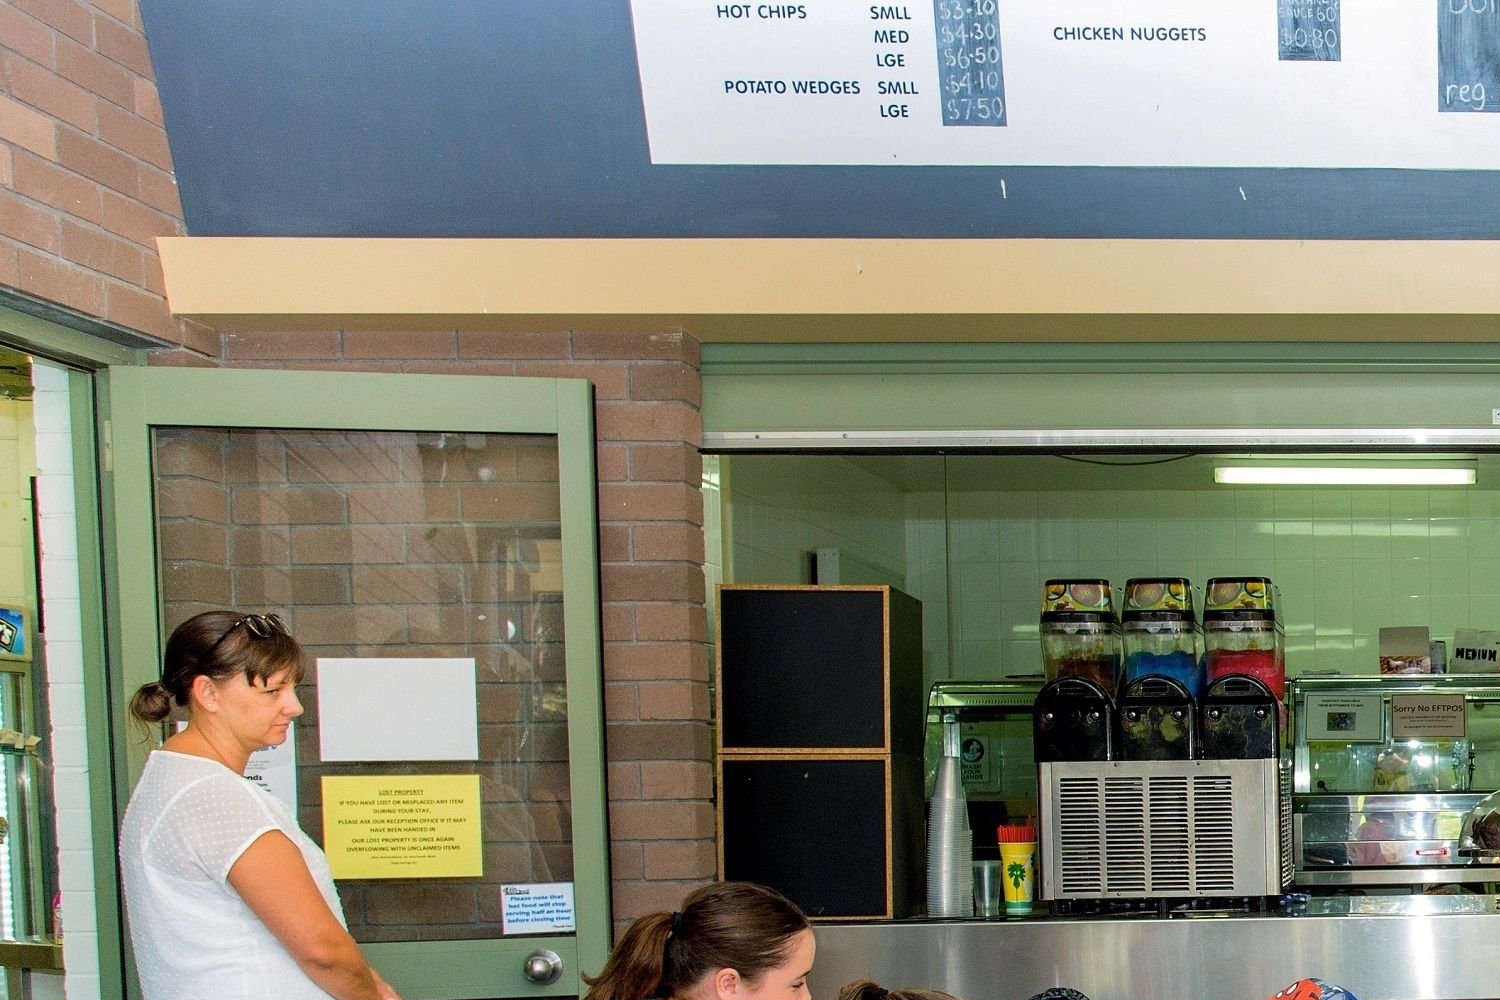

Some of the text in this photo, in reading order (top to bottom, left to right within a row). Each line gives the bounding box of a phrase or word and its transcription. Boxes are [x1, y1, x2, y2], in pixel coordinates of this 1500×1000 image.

[717, 5, 750, 19] HOT
[758, 5, 807, 19] CHIPS
[870, 6, 911, 20] SMLL
[874, 23, 996, 46] MED $4.30
[1053, 26, 1124, 41] CHICKEN
[1131, 27, 1207, 42] NUGGETS
[876, 46, 999, 69] LGE $6.50
[725, 71, 998, 95] POTATO WEDGES SMLL $4.10
[880, 97, 1003, 121] LGE $7.50
[1455, 647, 1497, 662] MEDIUM
[1394, 705, 1415, 713] Sorry
[1432, 704, 1463, 712] EFTPOS
